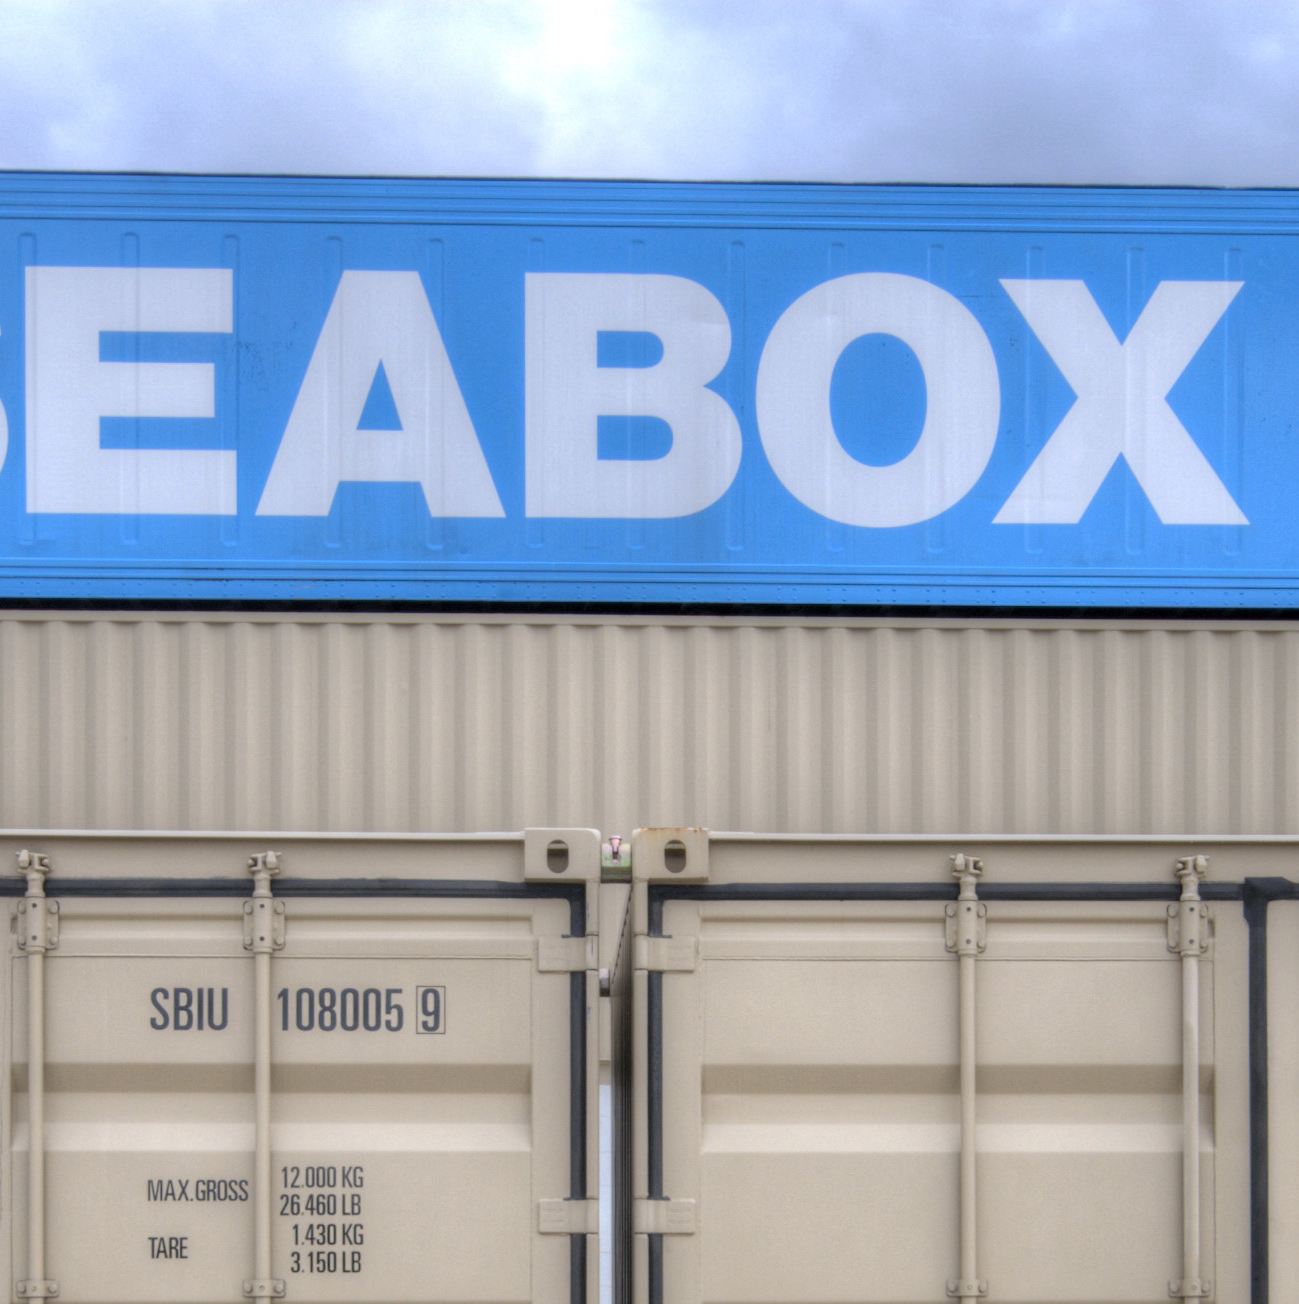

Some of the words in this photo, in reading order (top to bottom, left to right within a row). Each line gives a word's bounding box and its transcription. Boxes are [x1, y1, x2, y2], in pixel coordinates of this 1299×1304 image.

[150, 987, 229, 1031] SBIU
[277, 988, 404, 1032] 108005
[421, 988, 441, 1032] 9
[281, 1166, 337, 1188] 12.000
[342, 1166, 364, 1188] KG
[279, 1194, 337, 1216] 26.460
[342, 1194, 361, 1216] LB
[292, 1224, 337, 1246] 1.430
[342, 1224, 364, 1246] KG
[148, 1237, 188, 1259] TARE
[290, 1252, 337, 1273] 3.150
[342, 1252, 362, 1273] LB
